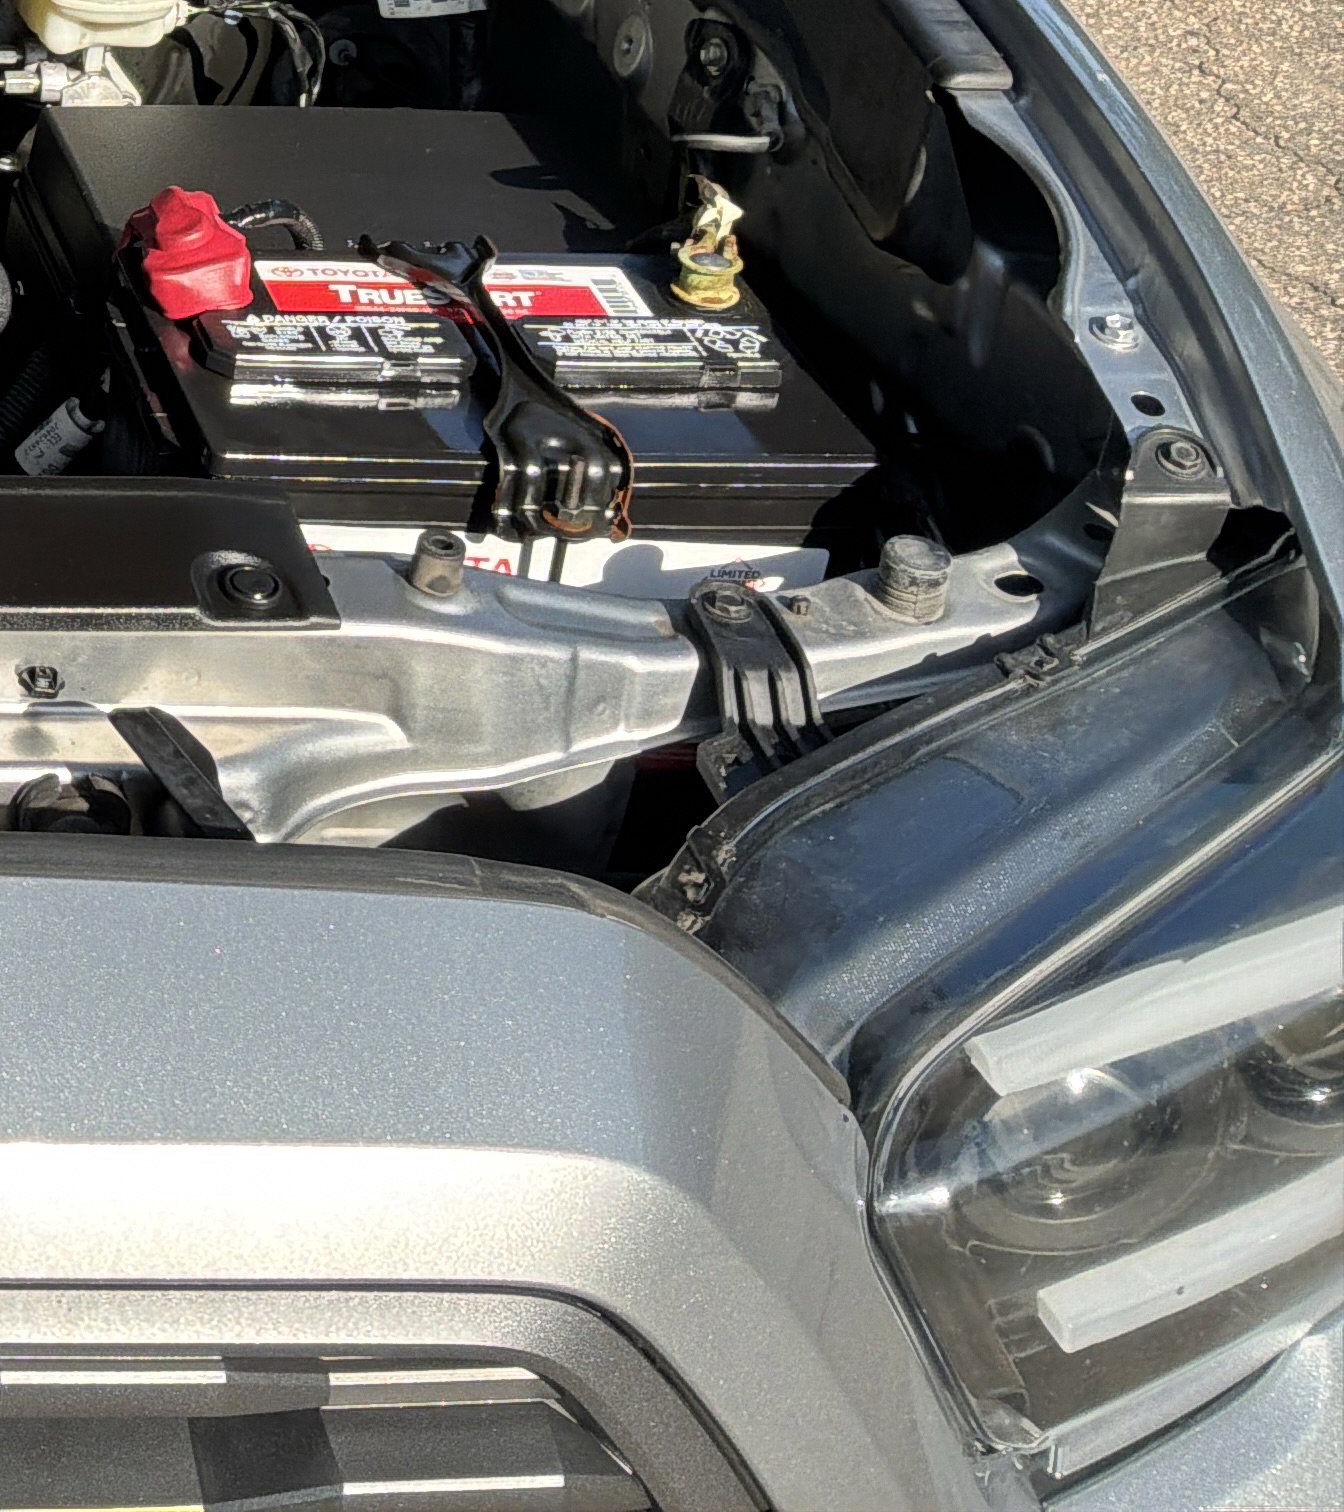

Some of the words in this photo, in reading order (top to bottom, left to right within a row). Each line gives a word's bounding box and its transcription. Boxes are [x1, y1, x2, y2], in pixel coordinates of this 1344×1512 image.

[262, 314, 330, 325] DANGER
[345, 315, 406, 325] POISON
[709, 569, 761, 579] LIMITED
